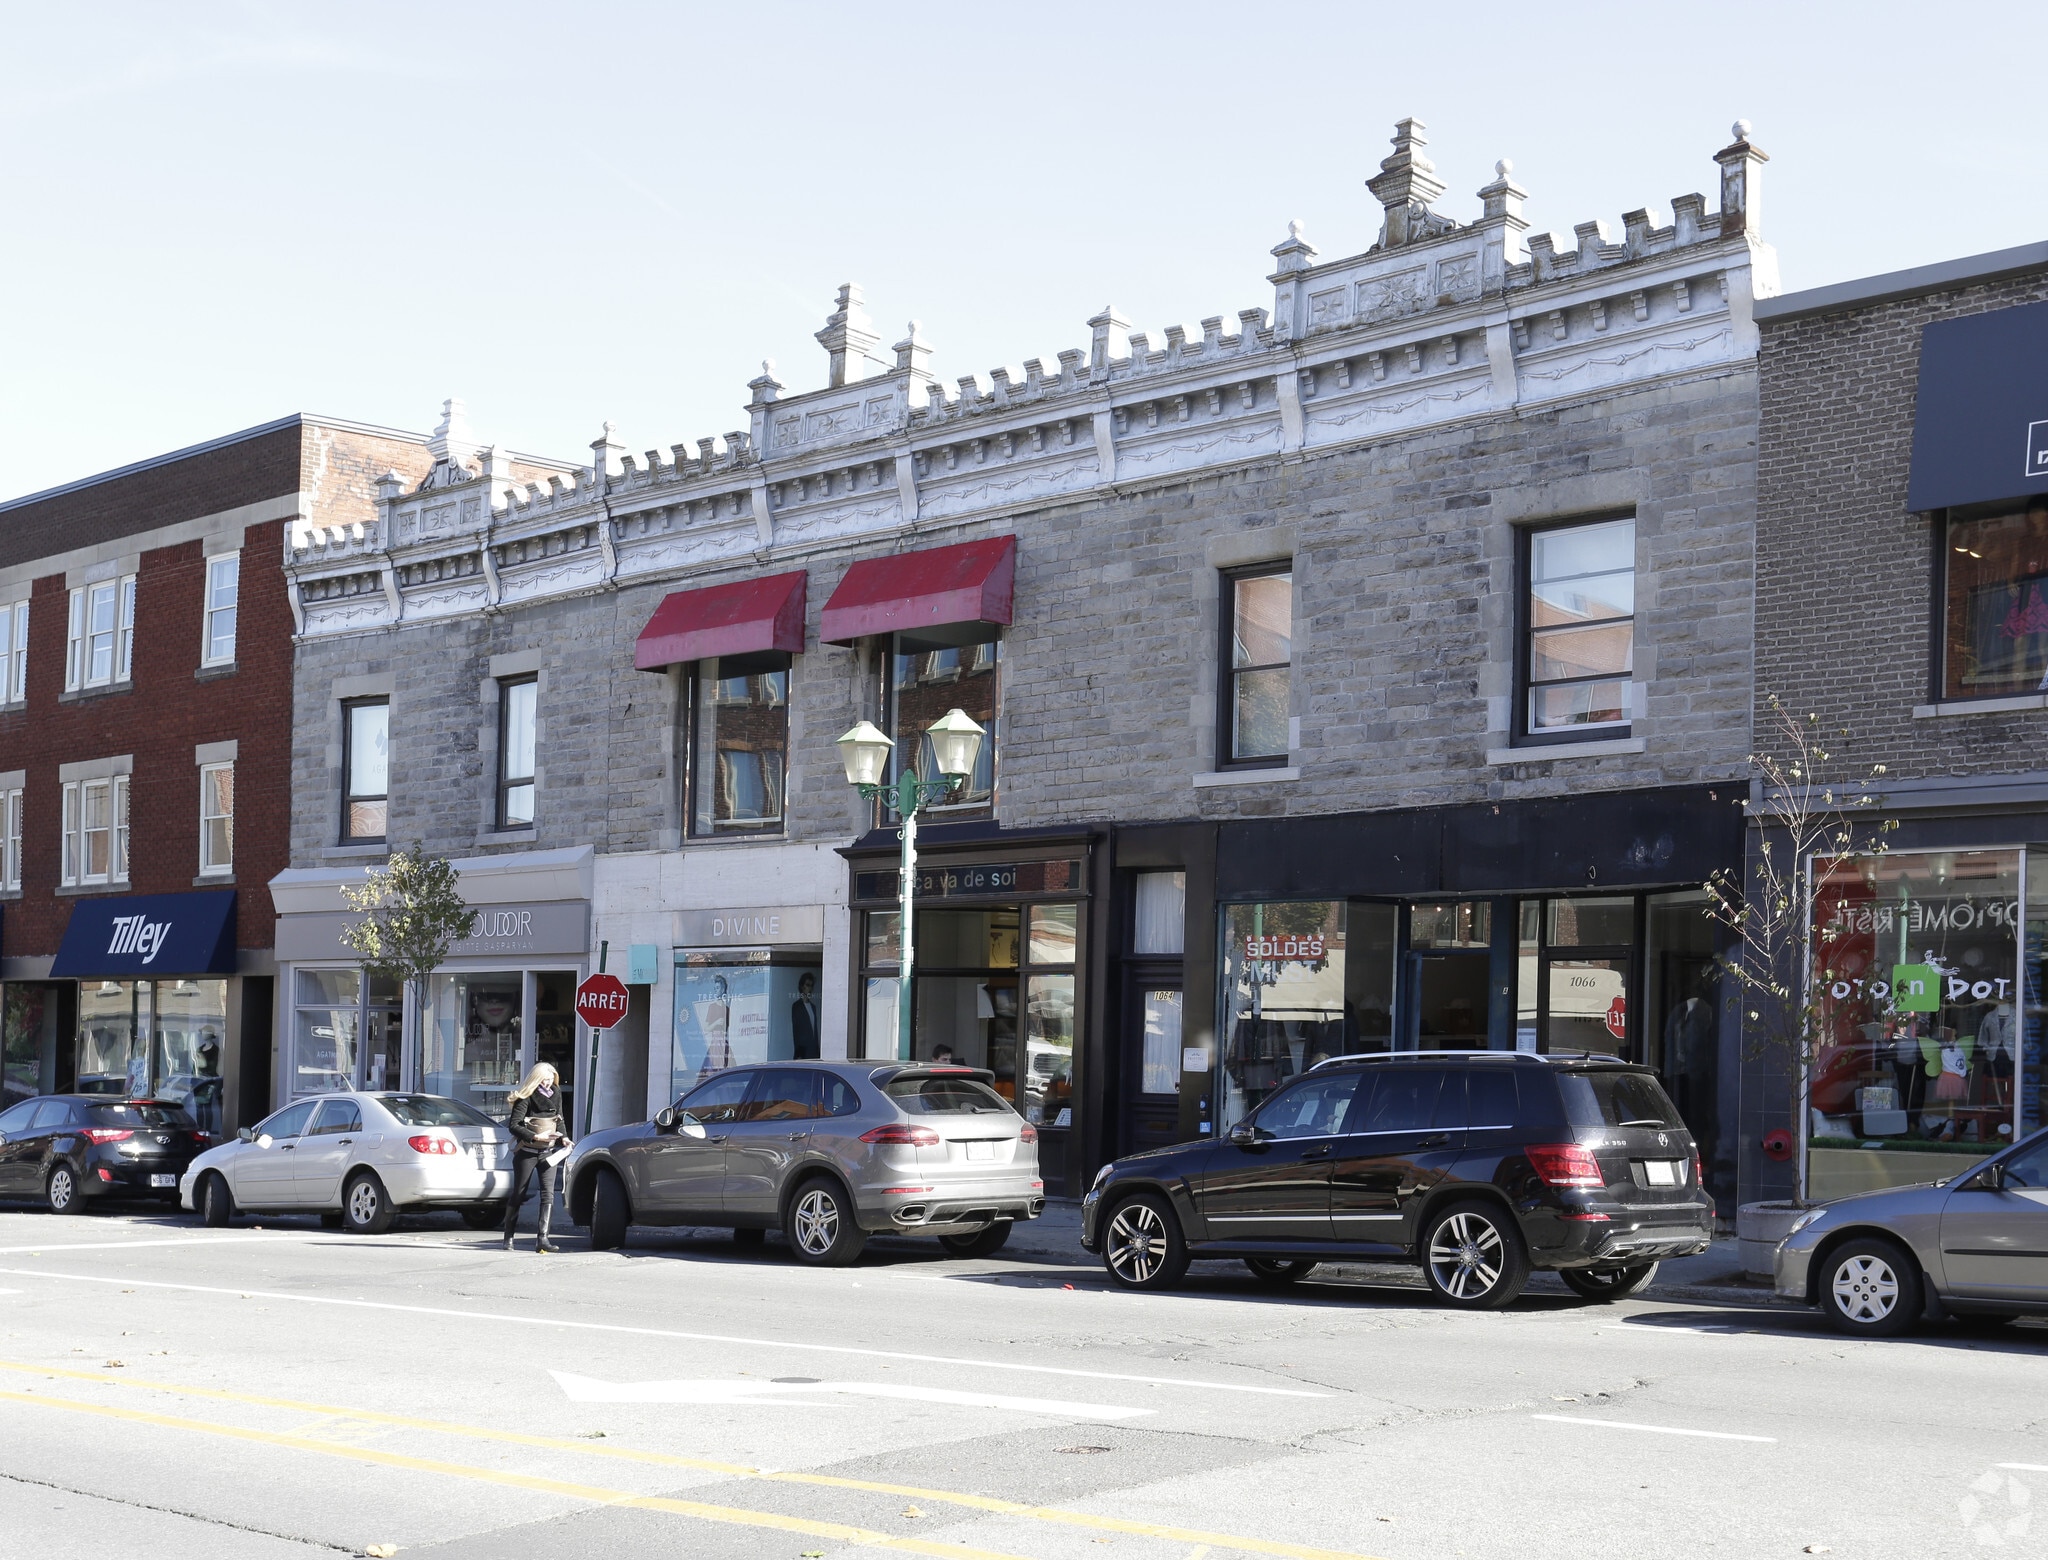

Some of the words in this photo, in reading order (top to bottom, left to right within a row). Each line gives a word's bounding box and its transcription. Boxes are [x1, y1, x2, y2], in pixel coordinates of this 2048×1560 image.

[940, 874, 957, 889] va
[964, 870, 984, 887] de
[991, 868, 1016, 886] soi
[462, 911, 533, 938] OUDOIR
[713, 916, 780, 937] DIVINE
[107, 914, 173, 965] Tilley
[1246, 941, 1323, 957] SOLDES
[1570, 976, 1596, 987] 1066
[1948, 976, 2011, 1001] DOT
[578, 990, 626, 1011] ARRÊT
[1155, 991, 1174, 1000] 1064
